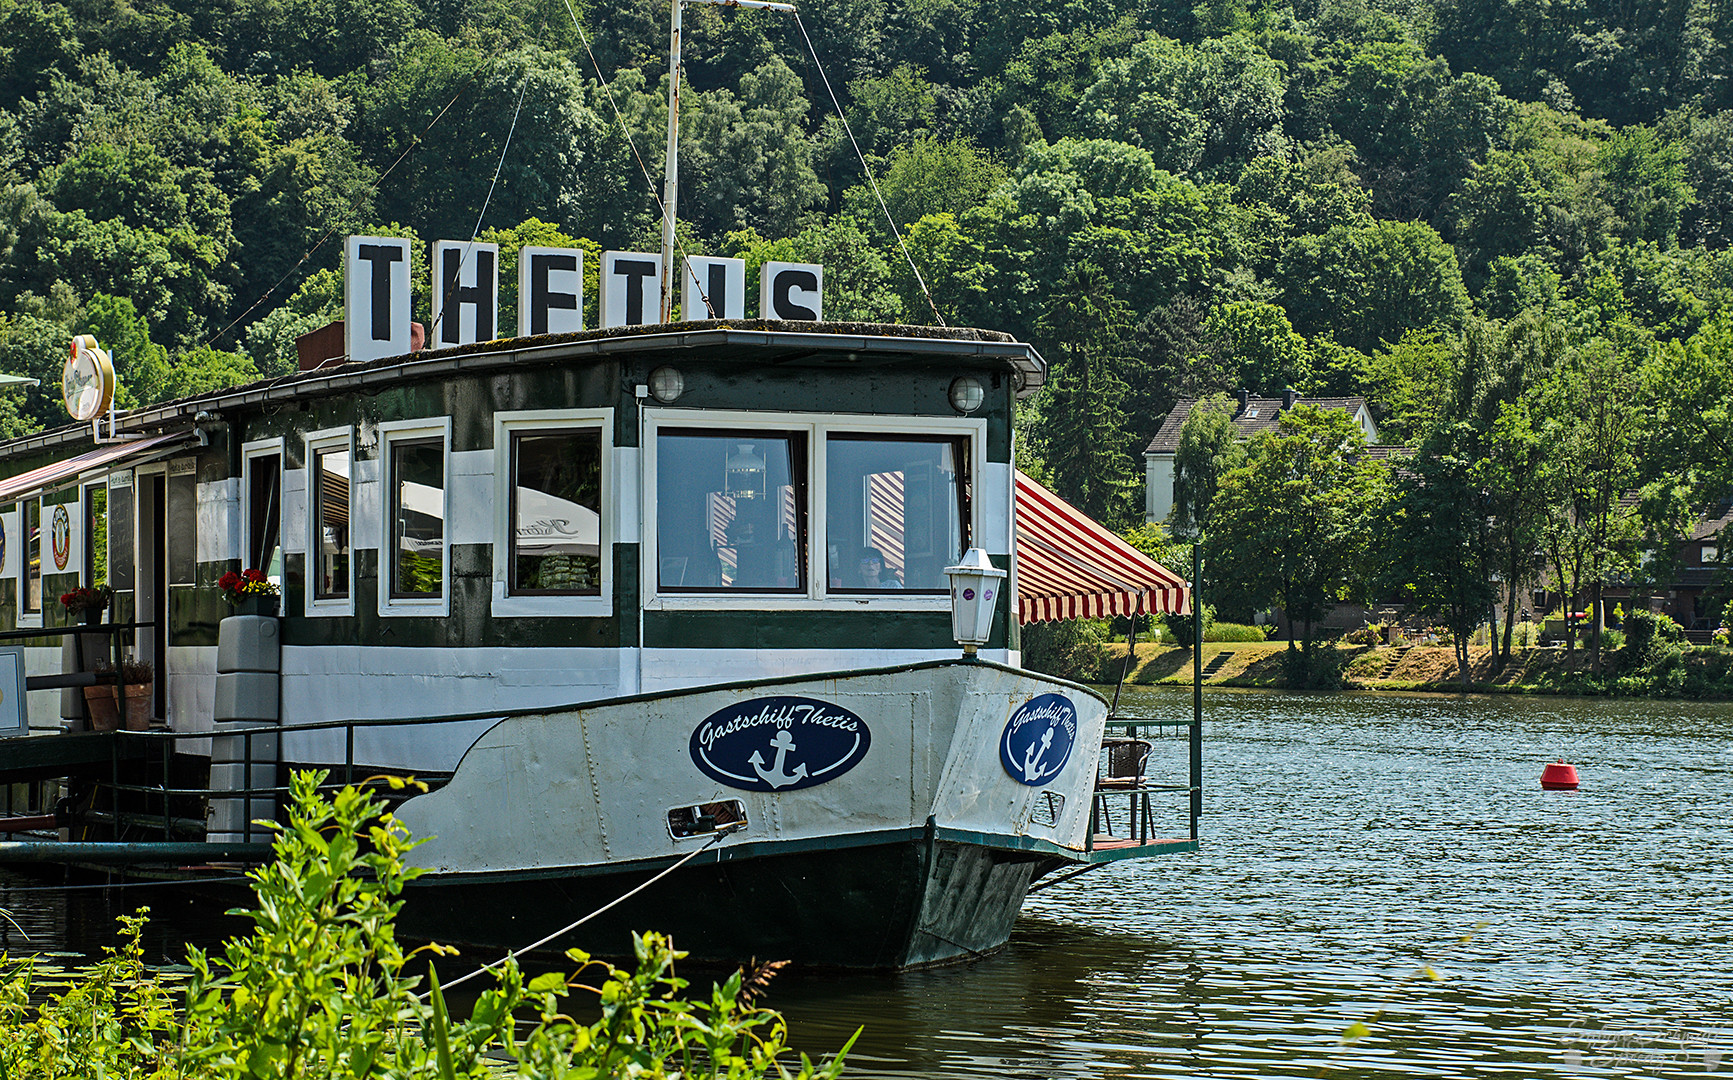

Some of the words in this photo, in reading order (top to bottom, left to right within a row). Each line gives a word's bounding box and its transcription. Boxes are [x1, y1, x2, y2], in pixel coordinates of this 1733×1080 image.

[699, 705, 796, 751] Gastschiff
[795, 704, 859, 732] Thetis
[1013, 701, 1063, 735] Gastschiff
[1060, 706, 1076, 740] Thetis
